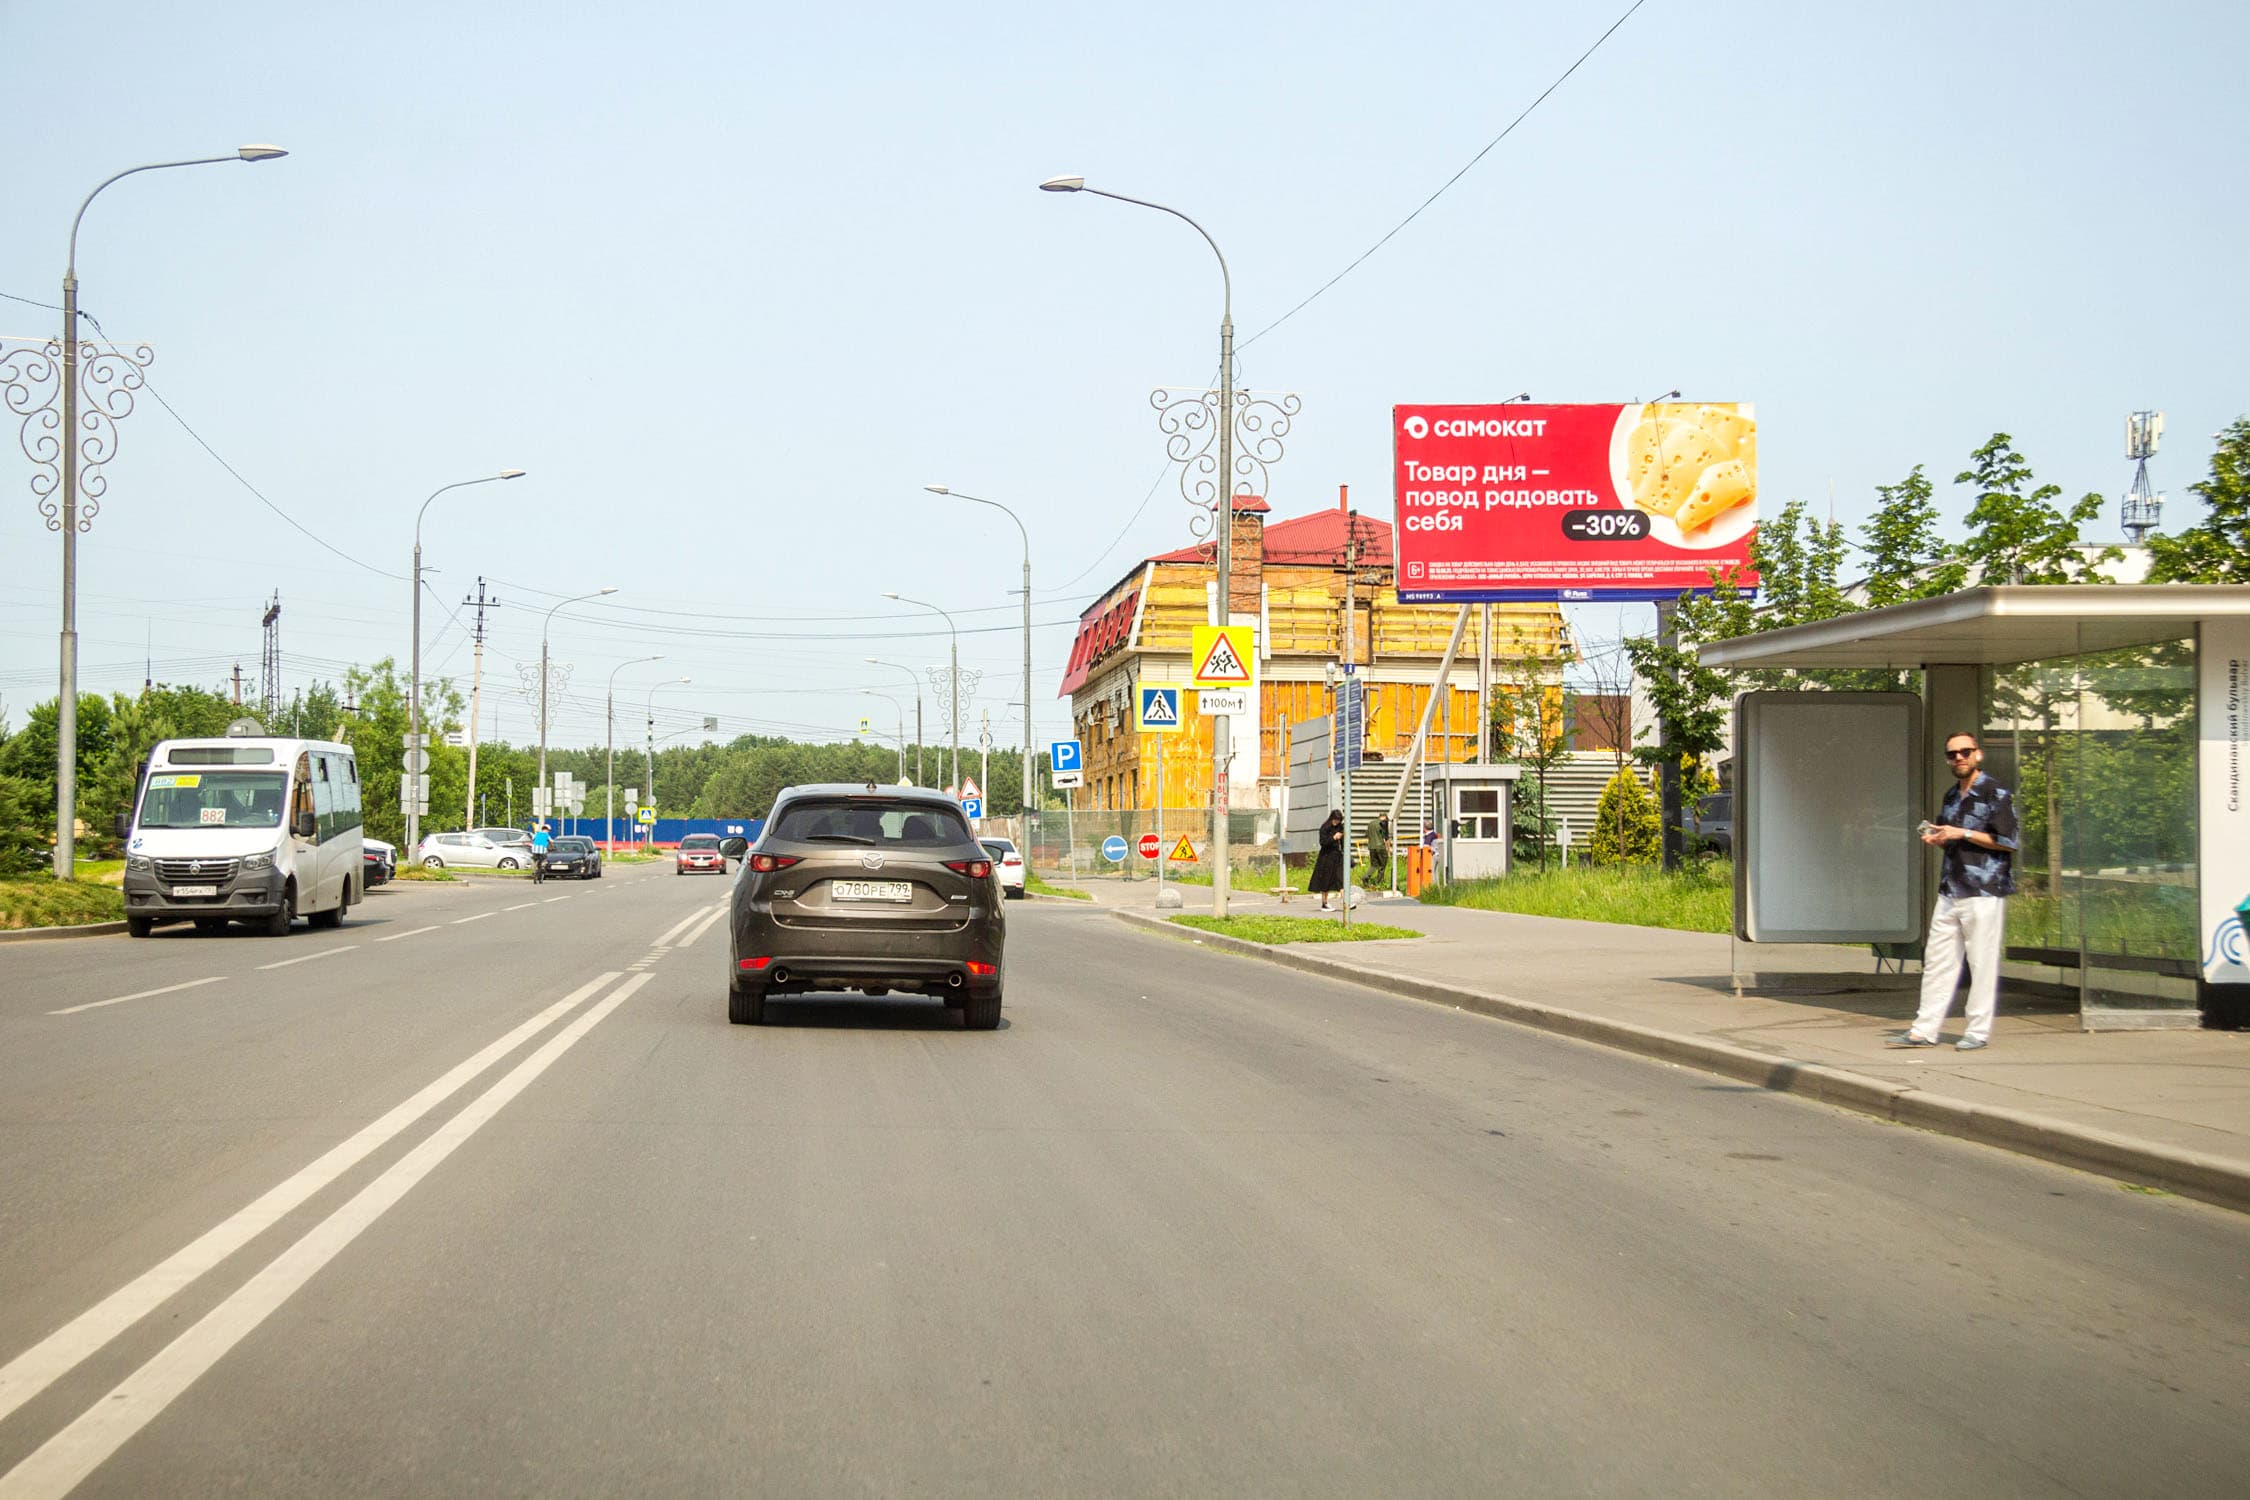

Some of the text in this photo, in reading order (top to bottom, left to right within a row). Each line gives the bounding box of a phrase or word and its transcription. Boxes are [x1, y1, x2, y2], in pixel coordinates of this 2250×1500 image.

[1433, 419, 1547, 437] самокат
[1404, 461, 1477, 486] Товар
[1482, 465, 1526, 484] дня
[1405, 490, 1599, 511] повод радовать
[1405, 510, 1463, 531] себя
[1572, 514, 1640, 535] -30%
[1209, 698, 1236, 709] 100м
[2228, 659, 2240, 812] Скандинавский бульвар
[1057, 744, 1075, 769] P
[202, 810, 225, 822] 882
[965, 801, 977, 818] P
